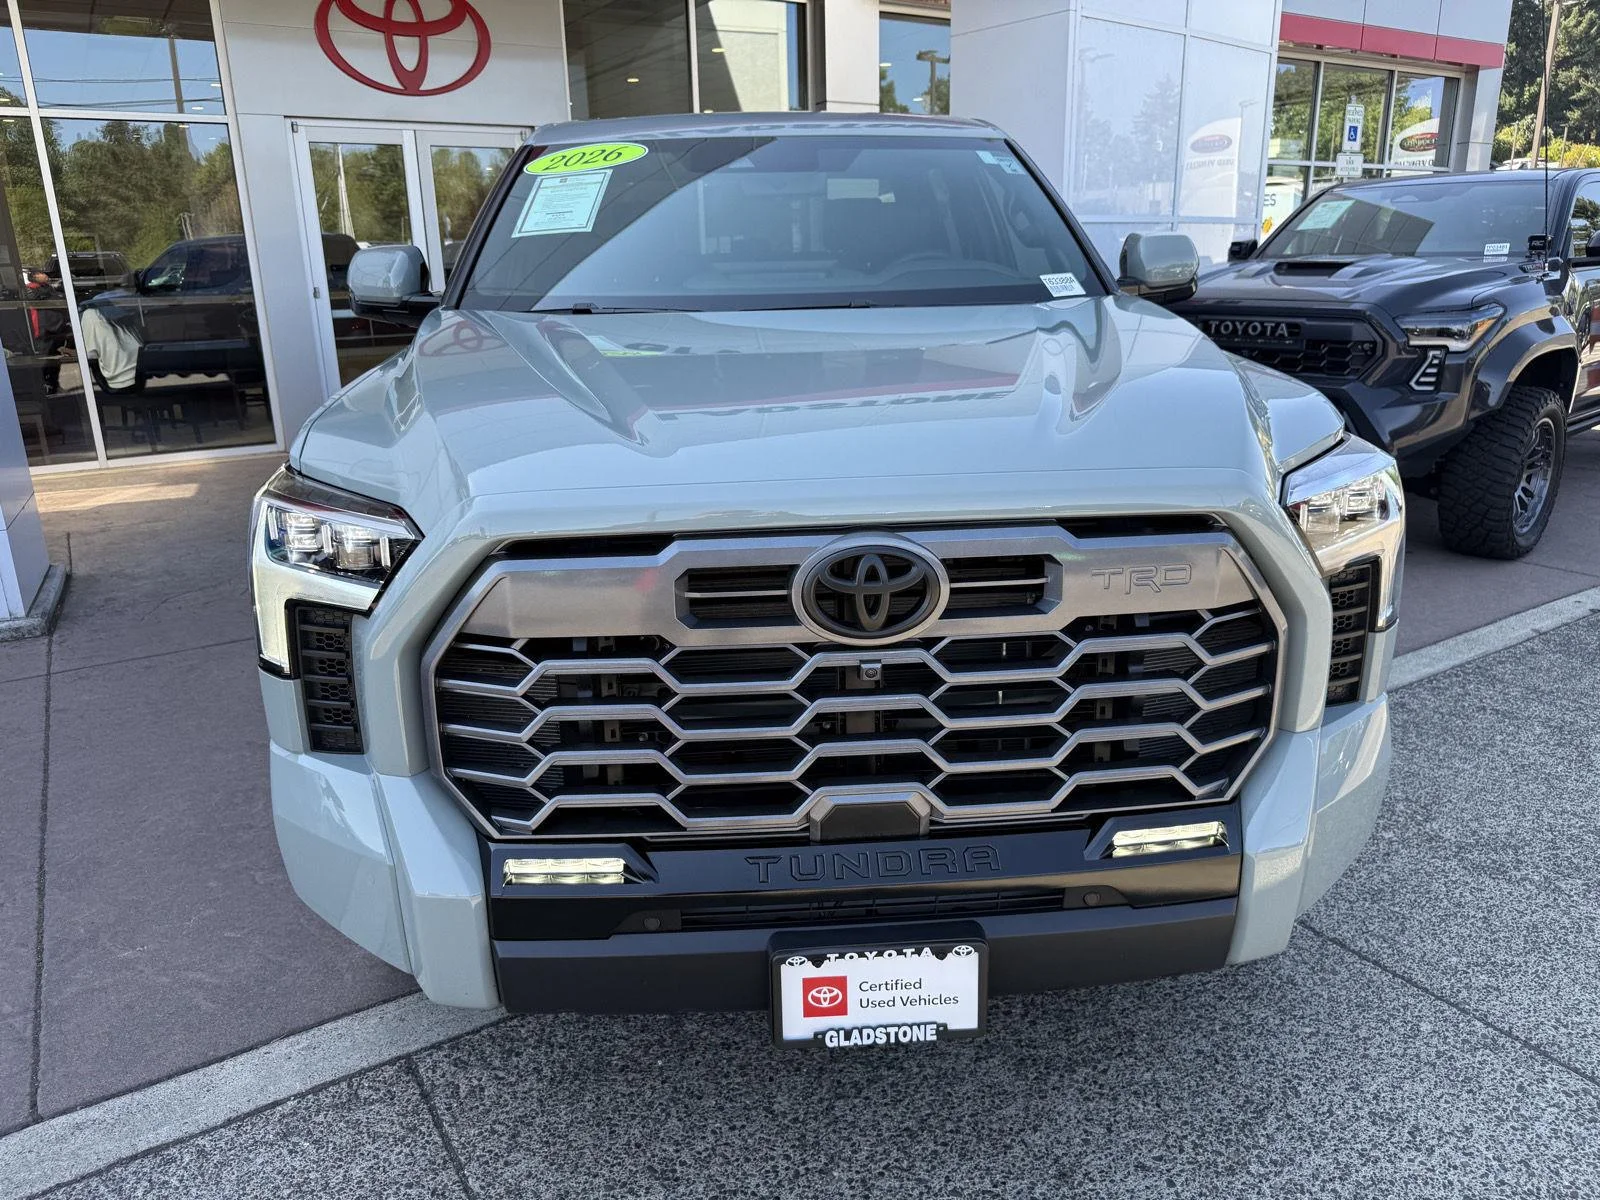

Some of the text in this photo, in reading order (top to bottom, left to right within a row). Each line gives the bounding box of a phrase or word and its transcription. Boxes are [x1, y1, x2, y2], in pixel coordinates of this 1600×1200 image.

[541, 145, 630, 171] 2026
[1208, 320, 1289, 337] TOYOTA
[1091, 563, 1192, 595] TRD
[744, 845, 1001, 884] TUNDRA
[826, 947, 935, 963] TOYOTA
[858, 977, 923, 993] Certified
[859, 994, 959, 1009] Used Vehicles
[824, 1023, 937, 1047] GLADSTONE
